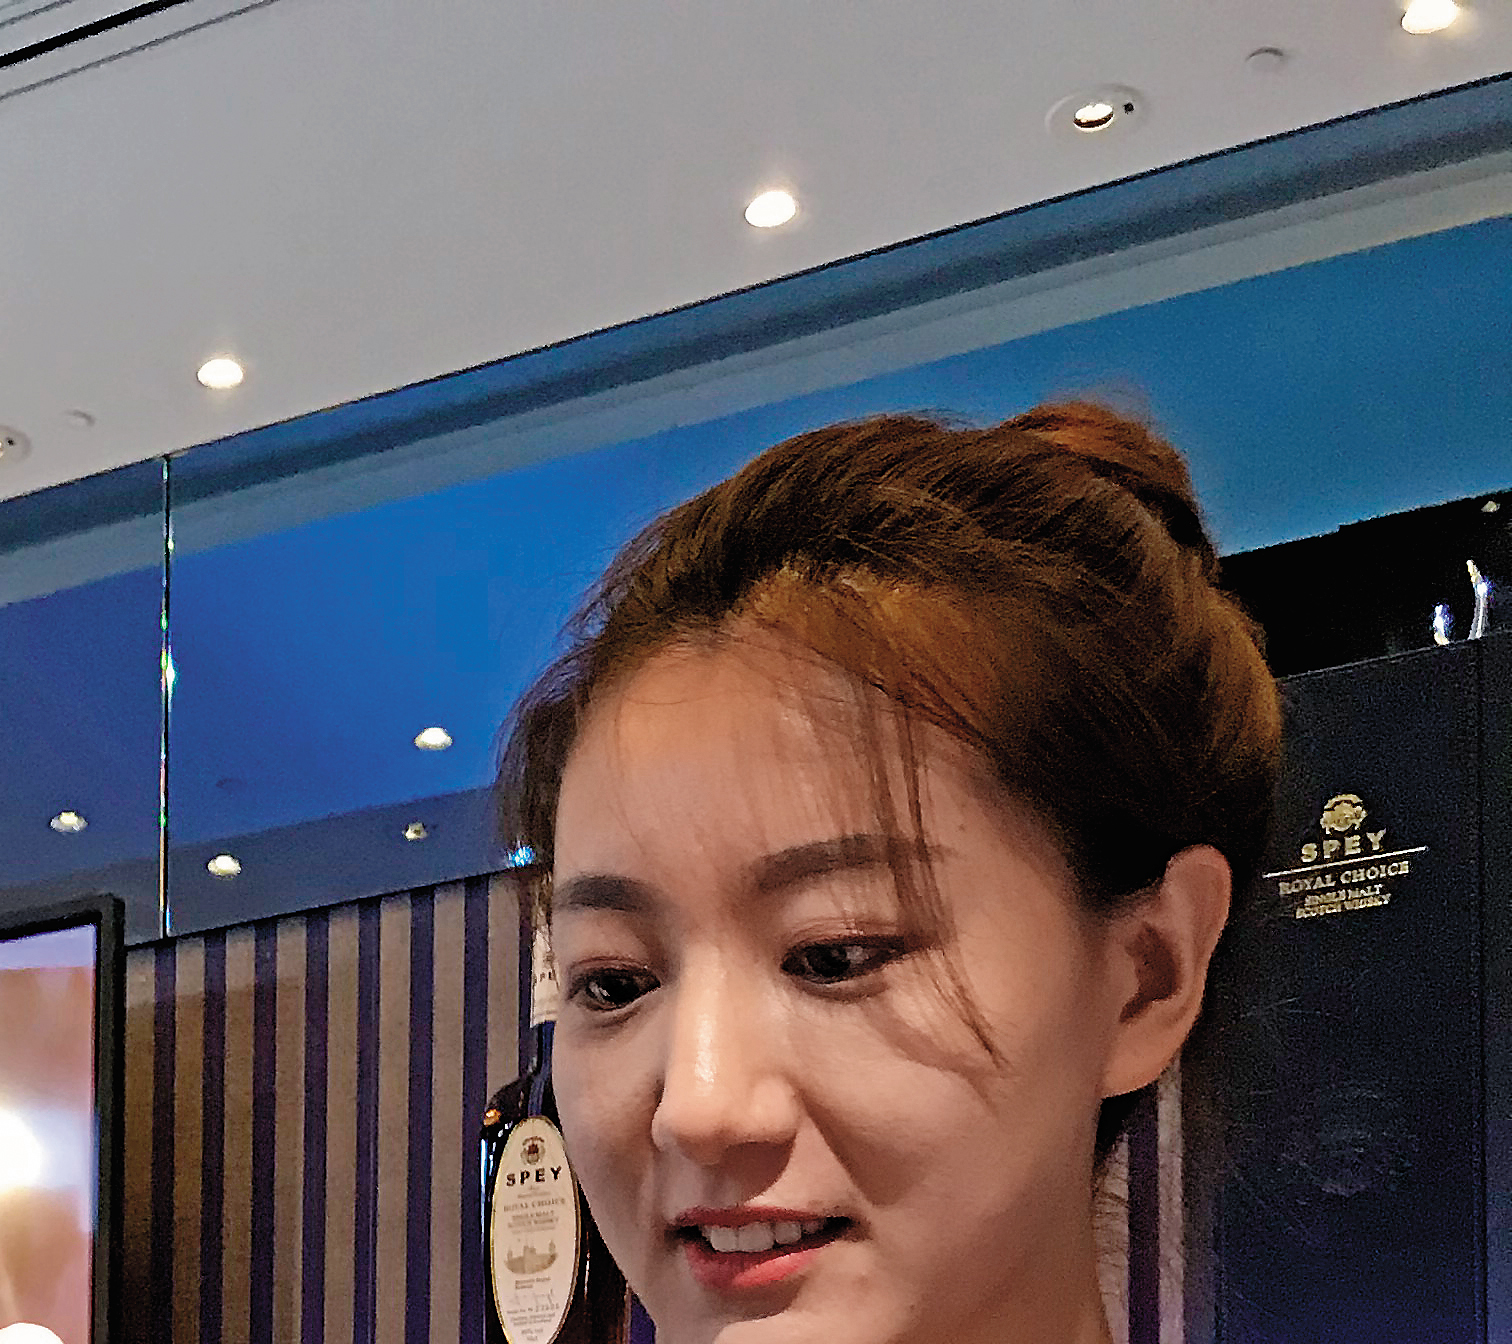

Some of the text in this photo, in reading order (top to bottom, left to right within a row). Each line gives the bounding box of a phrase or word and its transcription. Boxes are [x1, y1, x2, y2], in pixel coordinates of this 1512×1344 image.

[1300, 828, 1387, 863] SPEY
[1278, 860, 1410, 896] ROYAL CHOICE
[506, 1165, 562, 1187] SPEY
